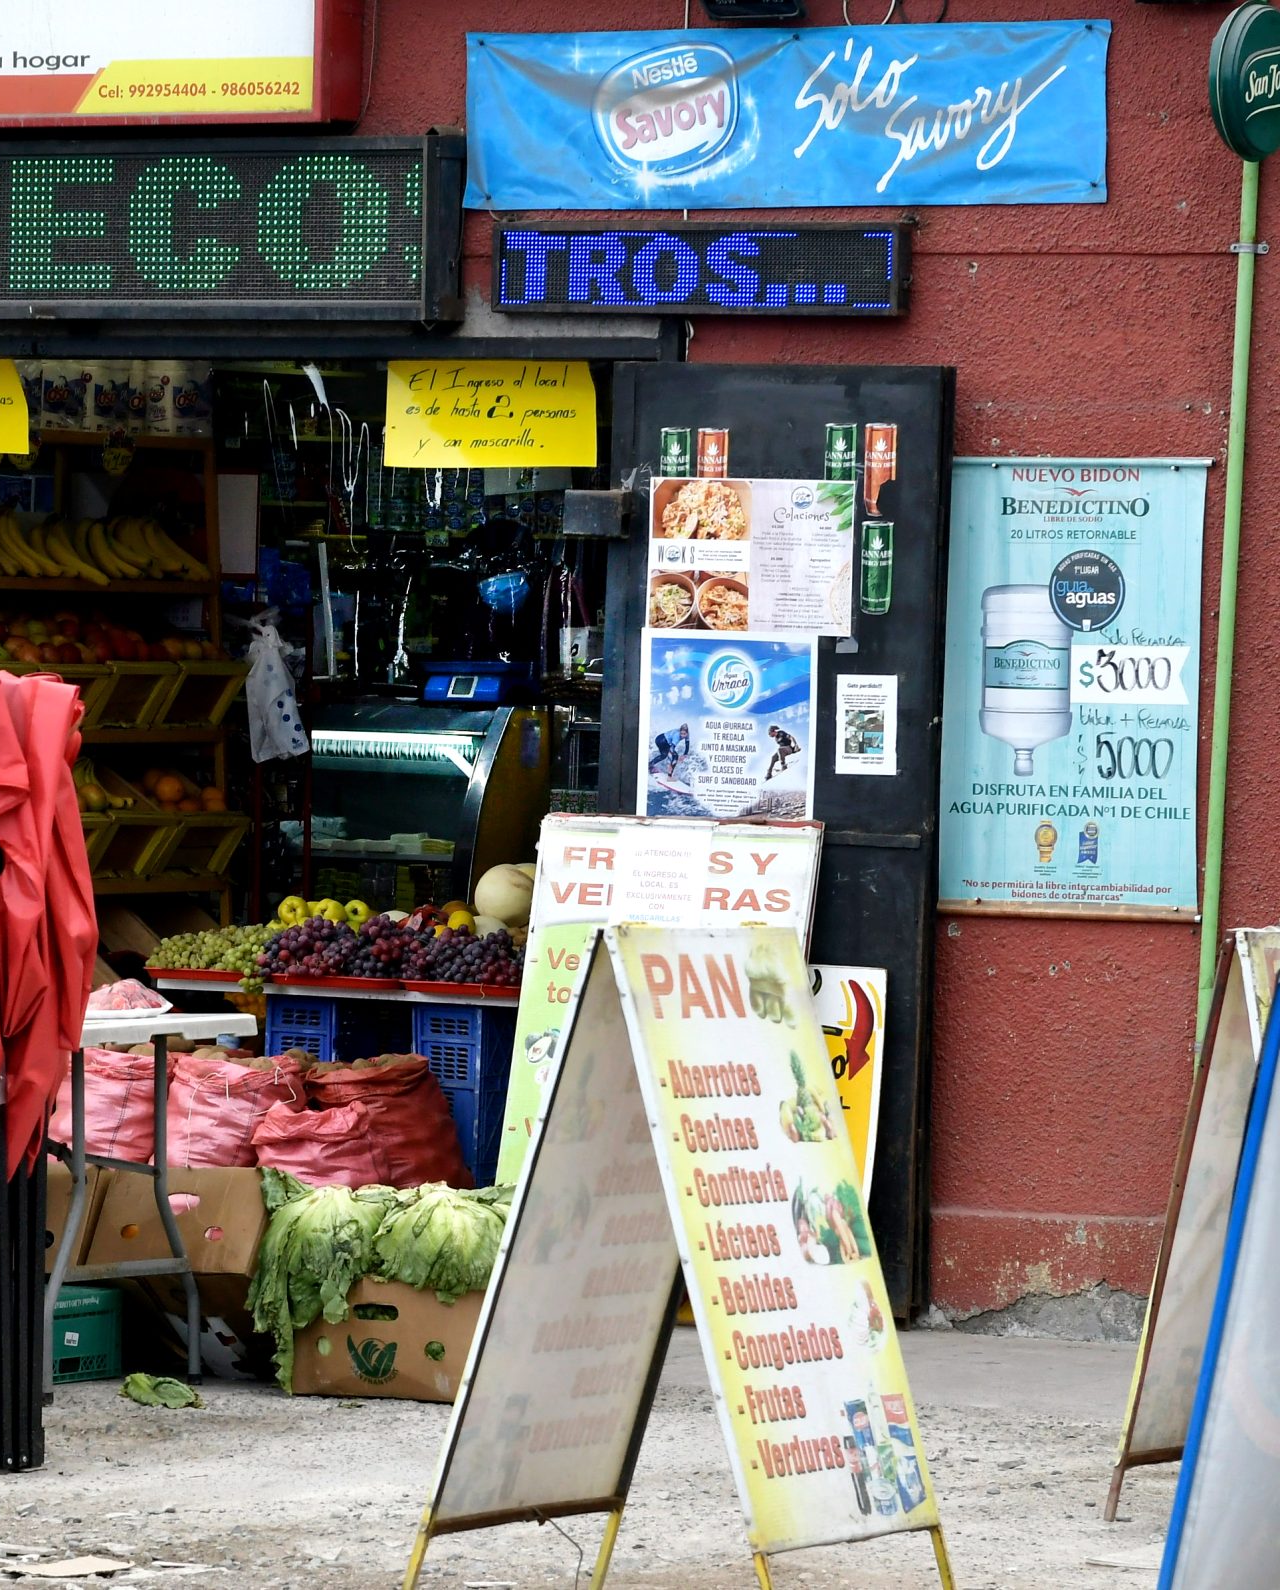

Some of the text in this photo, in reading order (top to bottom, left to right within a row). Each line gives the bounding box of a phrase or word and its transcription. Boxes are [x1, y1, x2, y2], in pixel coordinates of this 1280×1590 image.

[12, 50, 91, 71] hogar
[631, 53, 699, 88] Nestlé
[98, 81, 300, 99] Cel: 992954404 986056242
[1245, 70, 1269, 103] San
[615, 86, 726, 151] Savory
[877, 65, 1066, 193] Savory
[409, 364, 568, 397] El Ingreso al local
[405, 406, 420, 416] es
[425, 397, 440, 416] de
[451, 397, 480, 418] hasta
[520, 409, 577, 427] personas
[413, 438, 431, 458] y
[443, 439, 462, 449] con
[1012, 468, 1075, 483] NUEVO
[773, 507, 830, 524] Colaciones
[1001, 496, 1150, 517] BENEDICTINO
[1011, 529, 1137, 541] 20 LITROS RETORNABLE
[1065, 592, 1116, 609] aguas
[994, 657, 1061, 670] BENEDICTINO
[1079, 648, 1172, 693] $ 3000
[712, 677, 750, 694] Urraca
[705, 721, 753, 730] AGUA @URRACA
[722, 733, 745, 741] REGALA
[701, 743, 756, 752] JUNTO MASIKARA
[1096, 732, 1174, 781] 5000
[714, 755, 747, 763] ECORIDERS
[712, 766, 734, 774] CLASES
[698, 776, 757, 786] SURF SANDBOARD
[972, 783, 1167, 800] DISFRUTA EN FAMILIA DEL
[949, 801, 1192, 820] AGUA PURIFICADA DE CHILE
[751, 852, 779, 876] Y
[643, 871, 677, 879] INGRESO
[626, 891, 693, 901] EXCLUSIVAMENTE
[1011, 889, 1047, 899] bidones
[1061, 891, 1086, 900] otras
[1045, 880, 1172, 894] libre intercambiabilidad por
[641, 953, 746, 1020] PAN
[668, 1060, 761, 1098] Abarrotes
[680, 1113, 760, 1153] Cecinas
[693, 1162, 789, 1207] Confitería
[705, 1220, 781, 1262] Lácteos
[718, 1273, 798, 1316] Bebidas
[732, 1323, 844, 1371] Congelados
[744, 1384, 807, 1425] Frutas
[756, 1435, 846, 1479] Verduras
